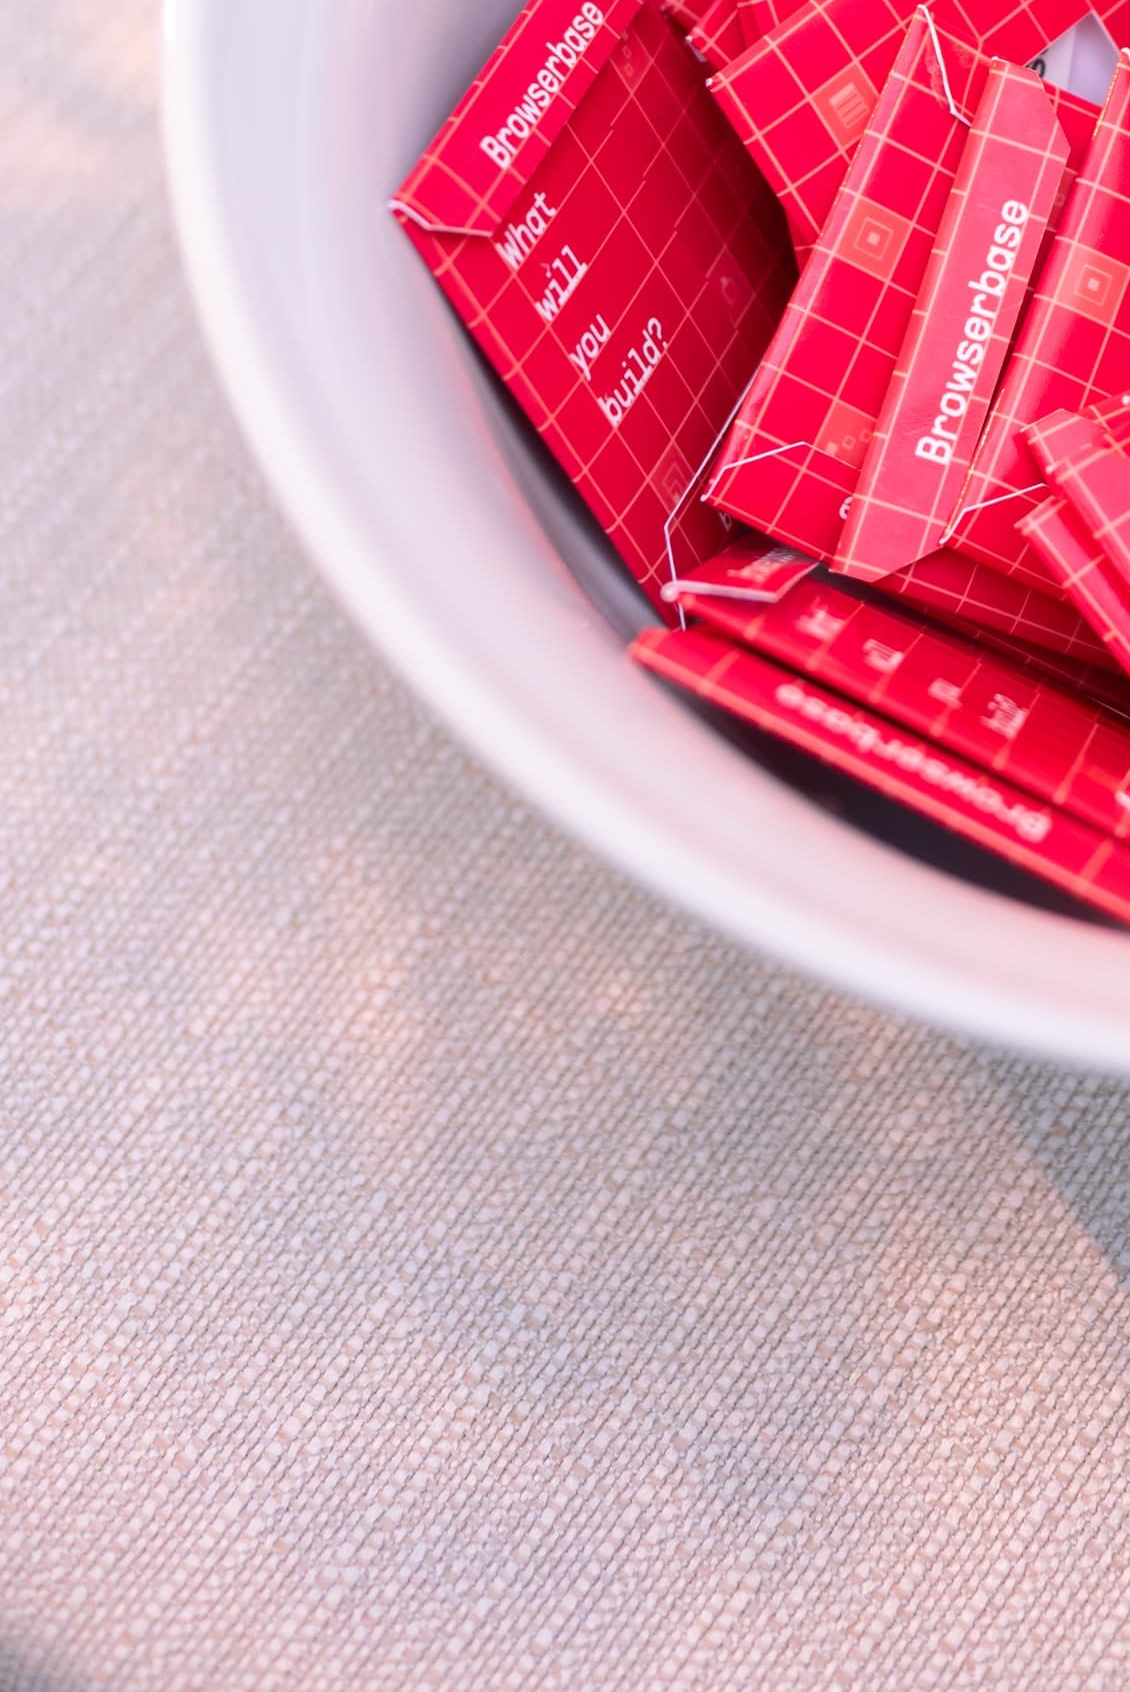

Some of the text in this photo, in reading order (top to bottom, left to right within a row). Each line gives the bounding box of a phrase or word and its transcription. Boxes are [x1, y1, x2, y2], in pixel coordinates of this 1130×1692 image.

[479, 1, 604, 170] Browserbase
[495, 190, 556, 271] What
[535, 245, 588, 322] will
[569, 313, 611, 382] you
[597, 317, 669, 427] build?
[915, 200, 1029, 465] Browserbase
